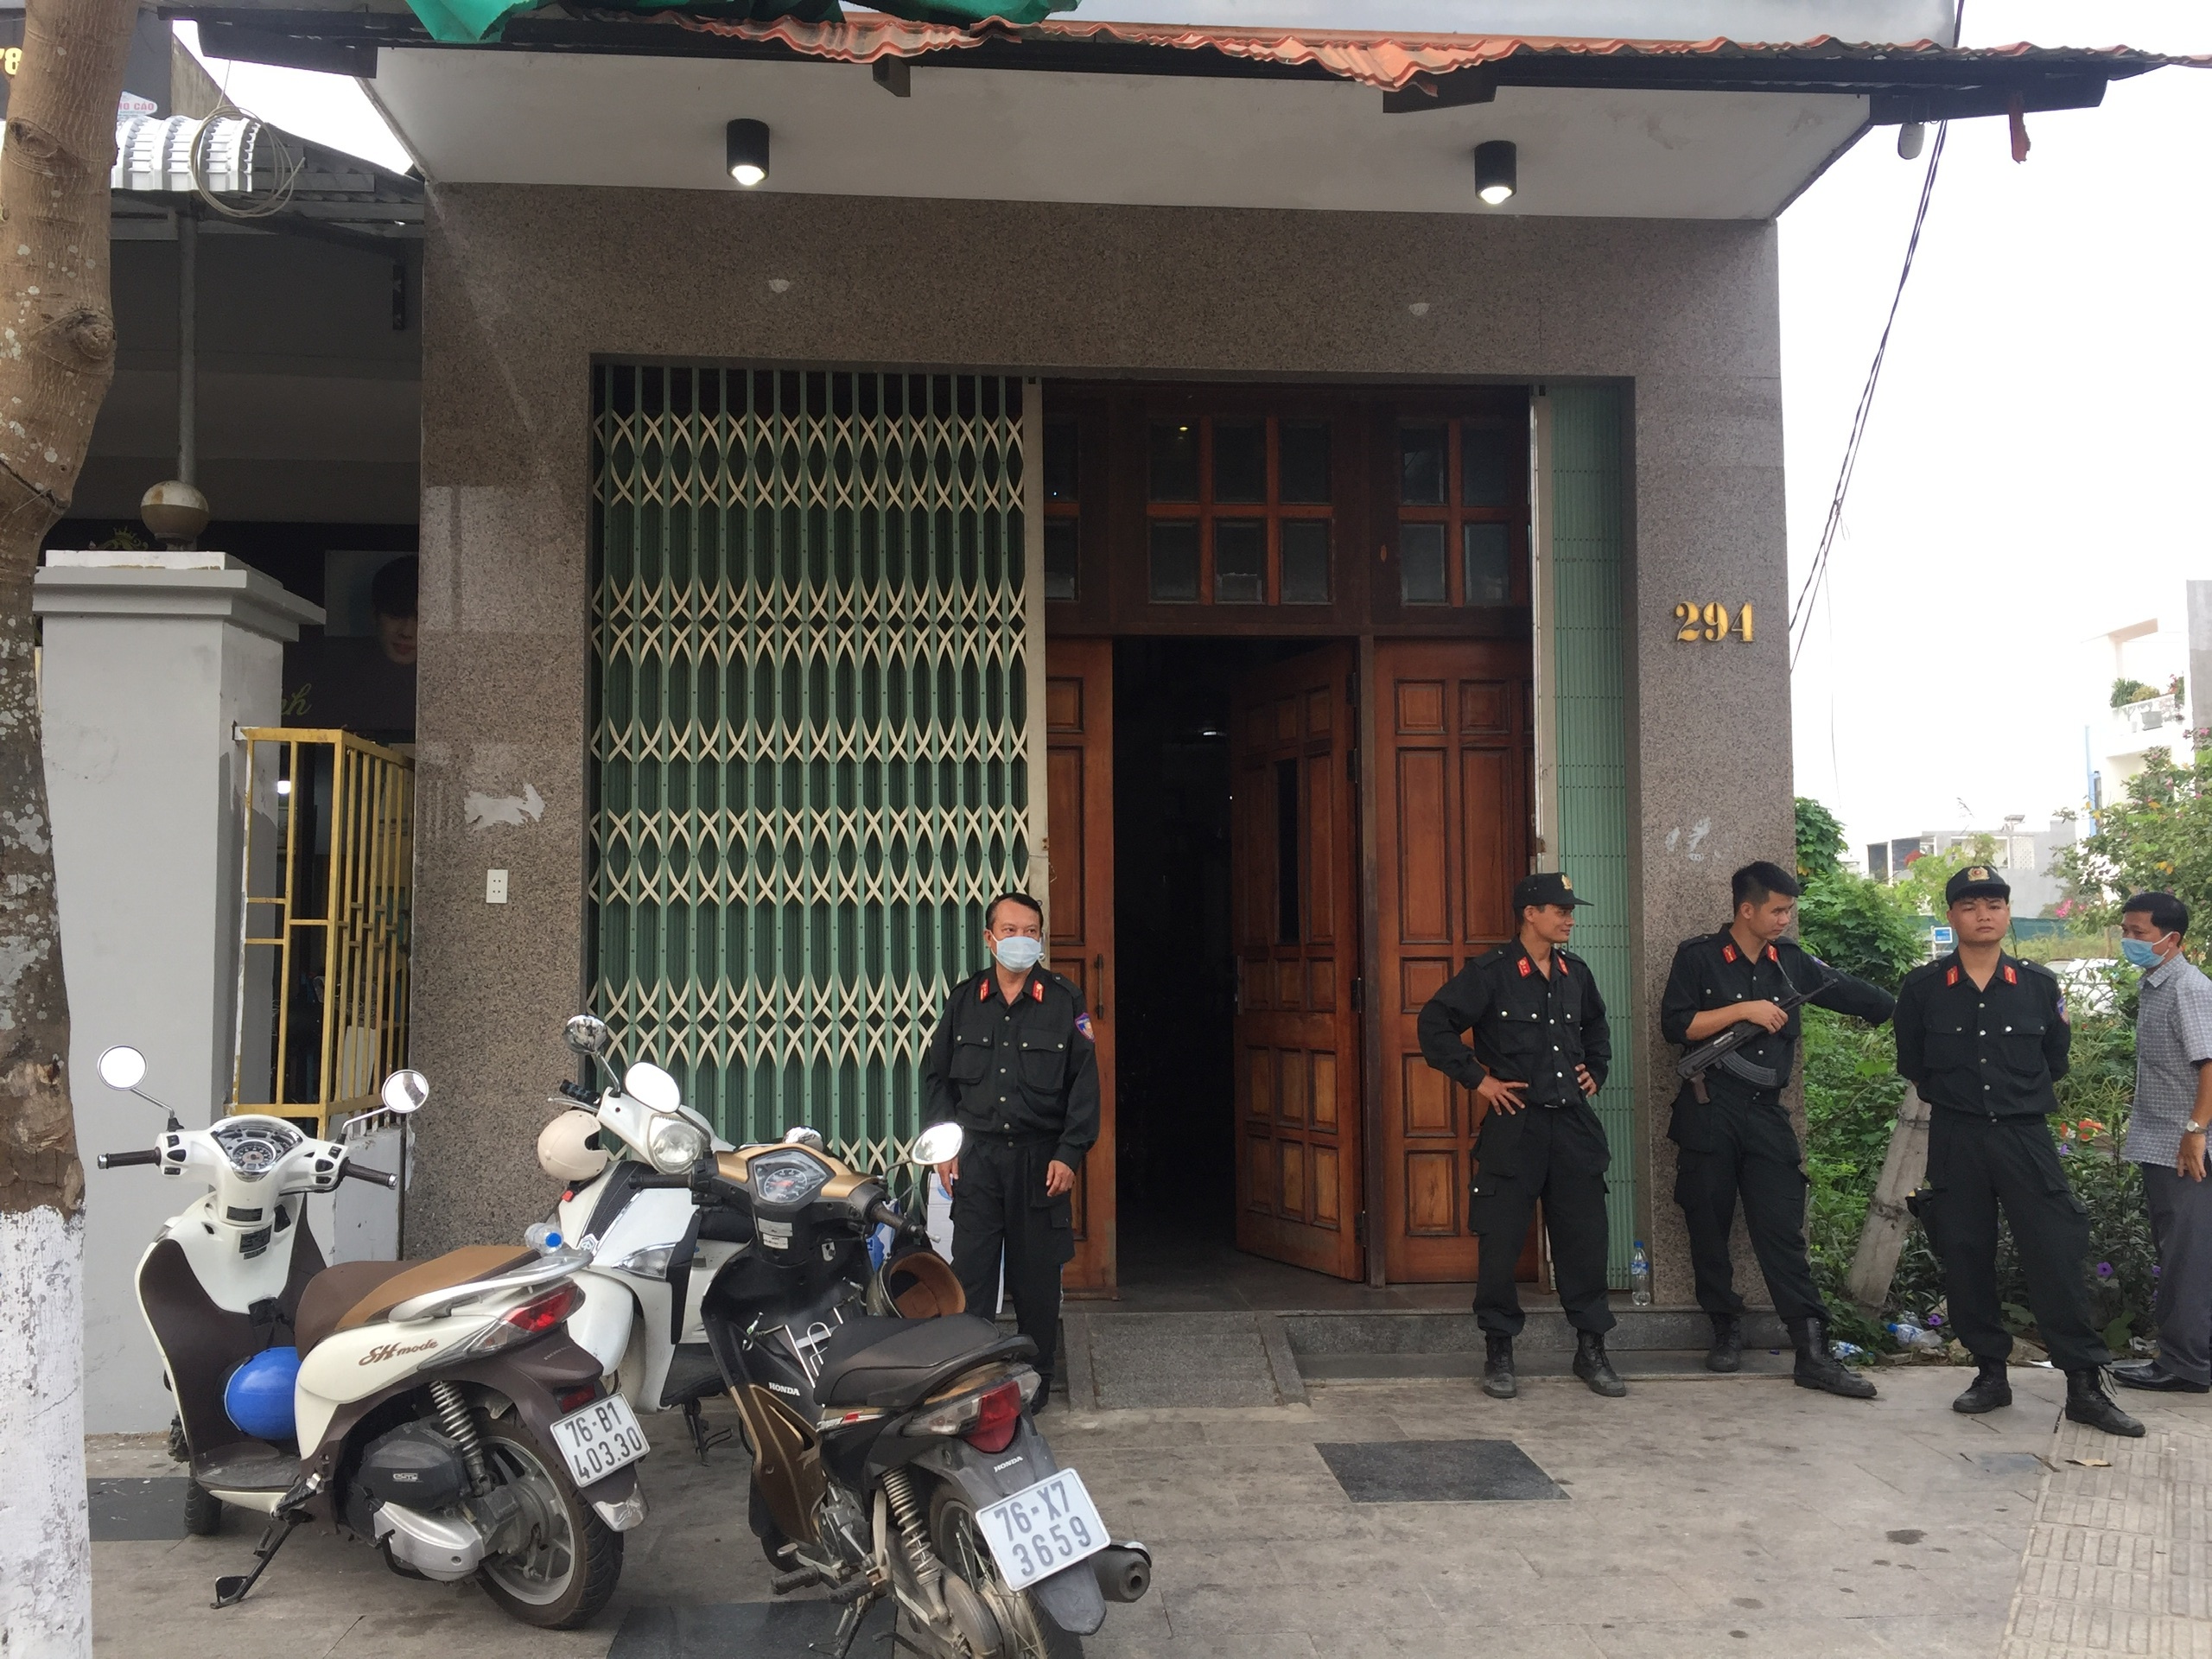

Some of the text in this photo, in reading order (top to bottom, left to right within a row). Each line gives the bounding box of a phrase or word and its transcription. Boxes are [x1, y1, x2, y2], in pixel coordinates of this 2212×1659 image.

[0, 48, 22, 75] 8
[1675, 601, 1756, 642] 294
[359, 1338, 439, 1366] SH mode
[768, 1382, 800, 1396] HONDA
[564, 1402, 621, 1448] 76-B1
[574, 1426, 642, 1479] 403.30
[994, 1456, 1023, 1472] HONDA
[994, 1480, 1070, 1541] 76-X7
[1012, 1516, 1091, 1577] 3659
